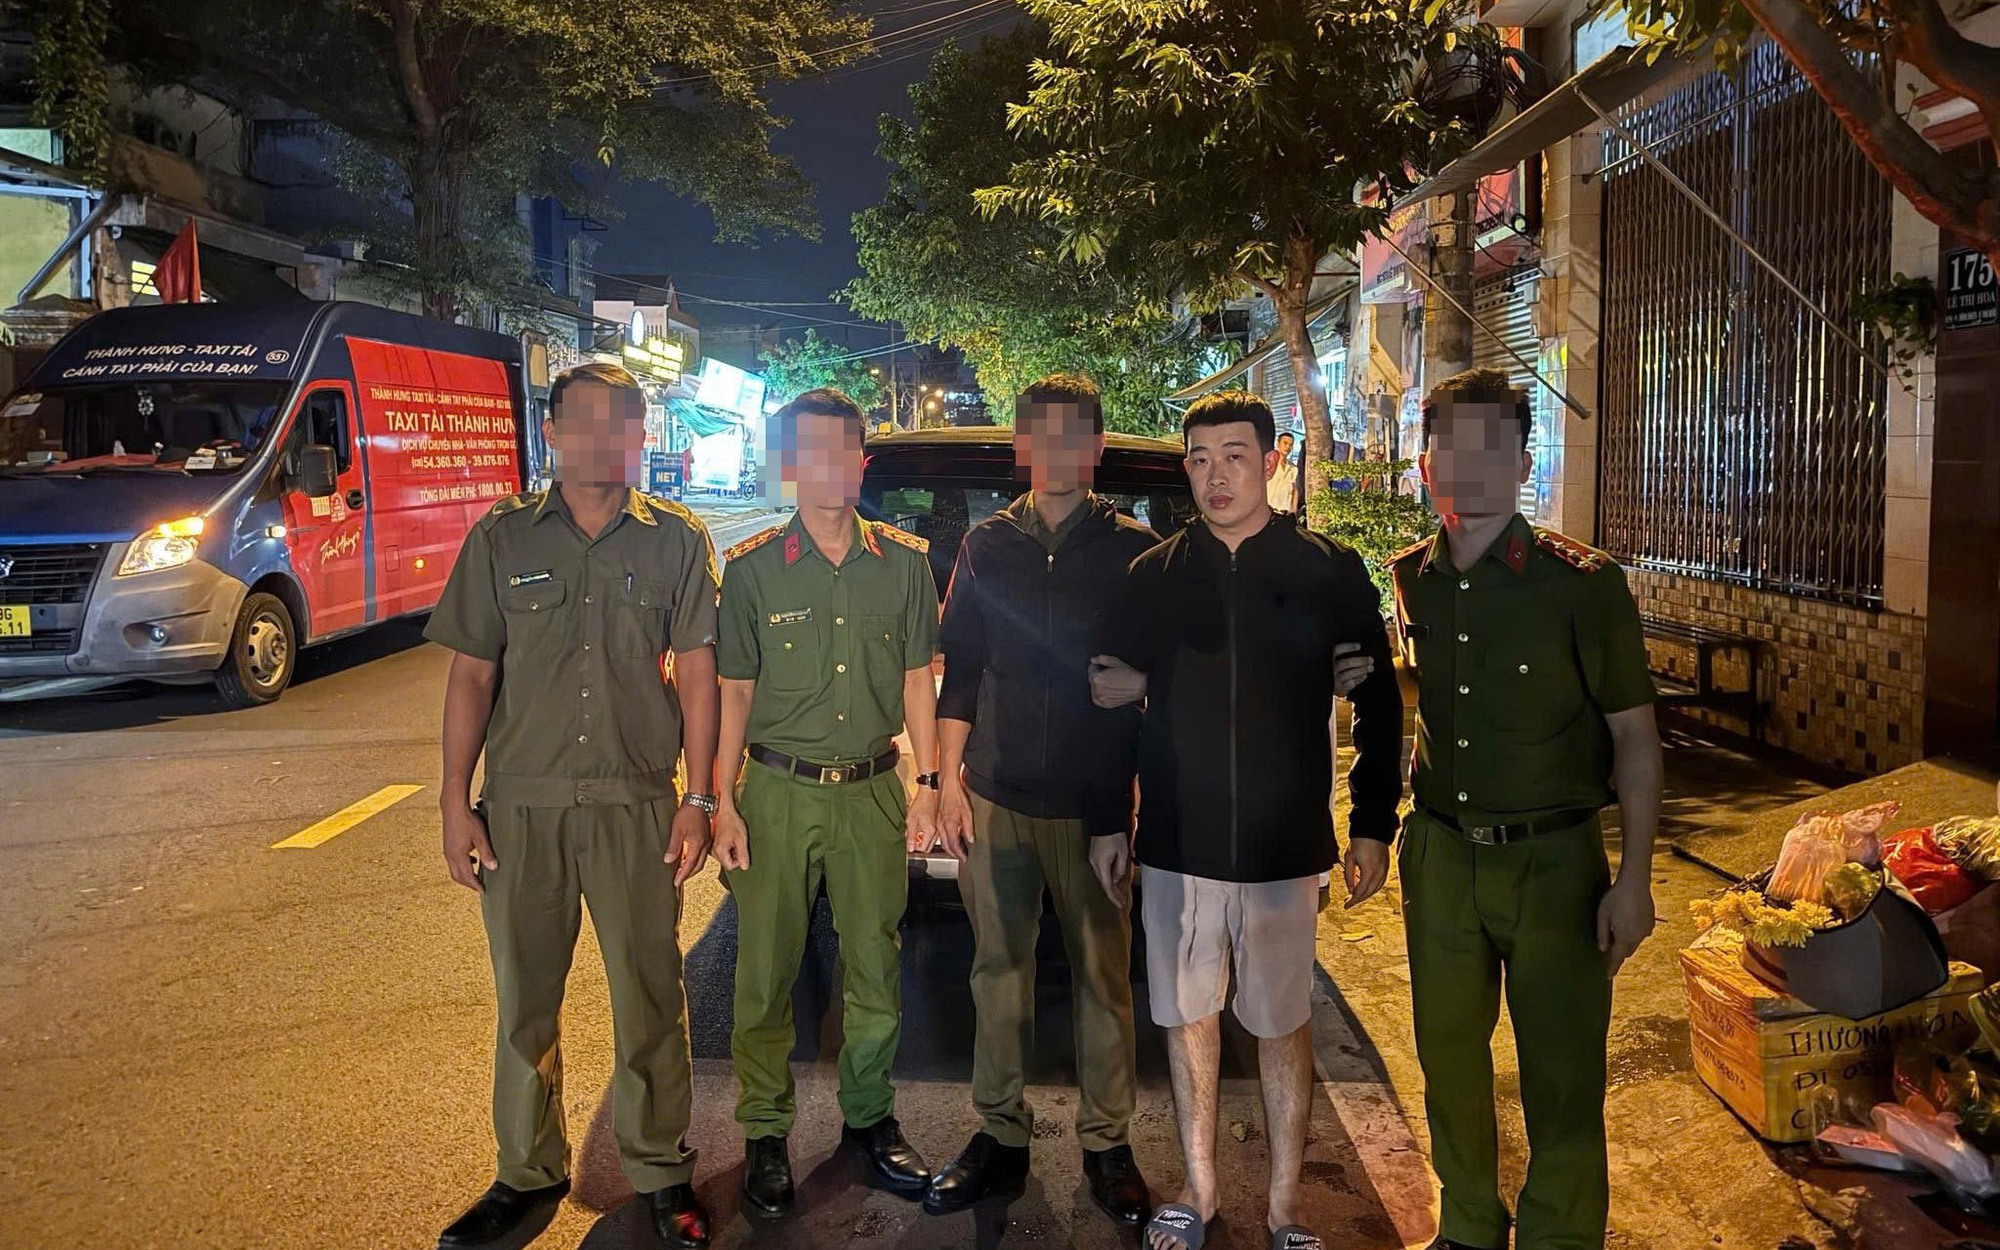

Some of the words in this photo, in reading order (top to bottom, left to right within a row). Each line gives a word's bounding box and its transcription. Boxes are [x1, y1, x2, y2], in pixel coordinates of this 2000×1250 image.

[1950, 253, 1994, 291] 175
[193, 345, 230, 356] TAXI
[108, 363, 140, 374] TAY
[385, 411, 419, 432] TAXI
[421, 410, 444, 433] TẢI
[446, 410, 490, 433] THÀNH
[656, 471, 677, 483] NET
[0, 621, 23, 635] .11
